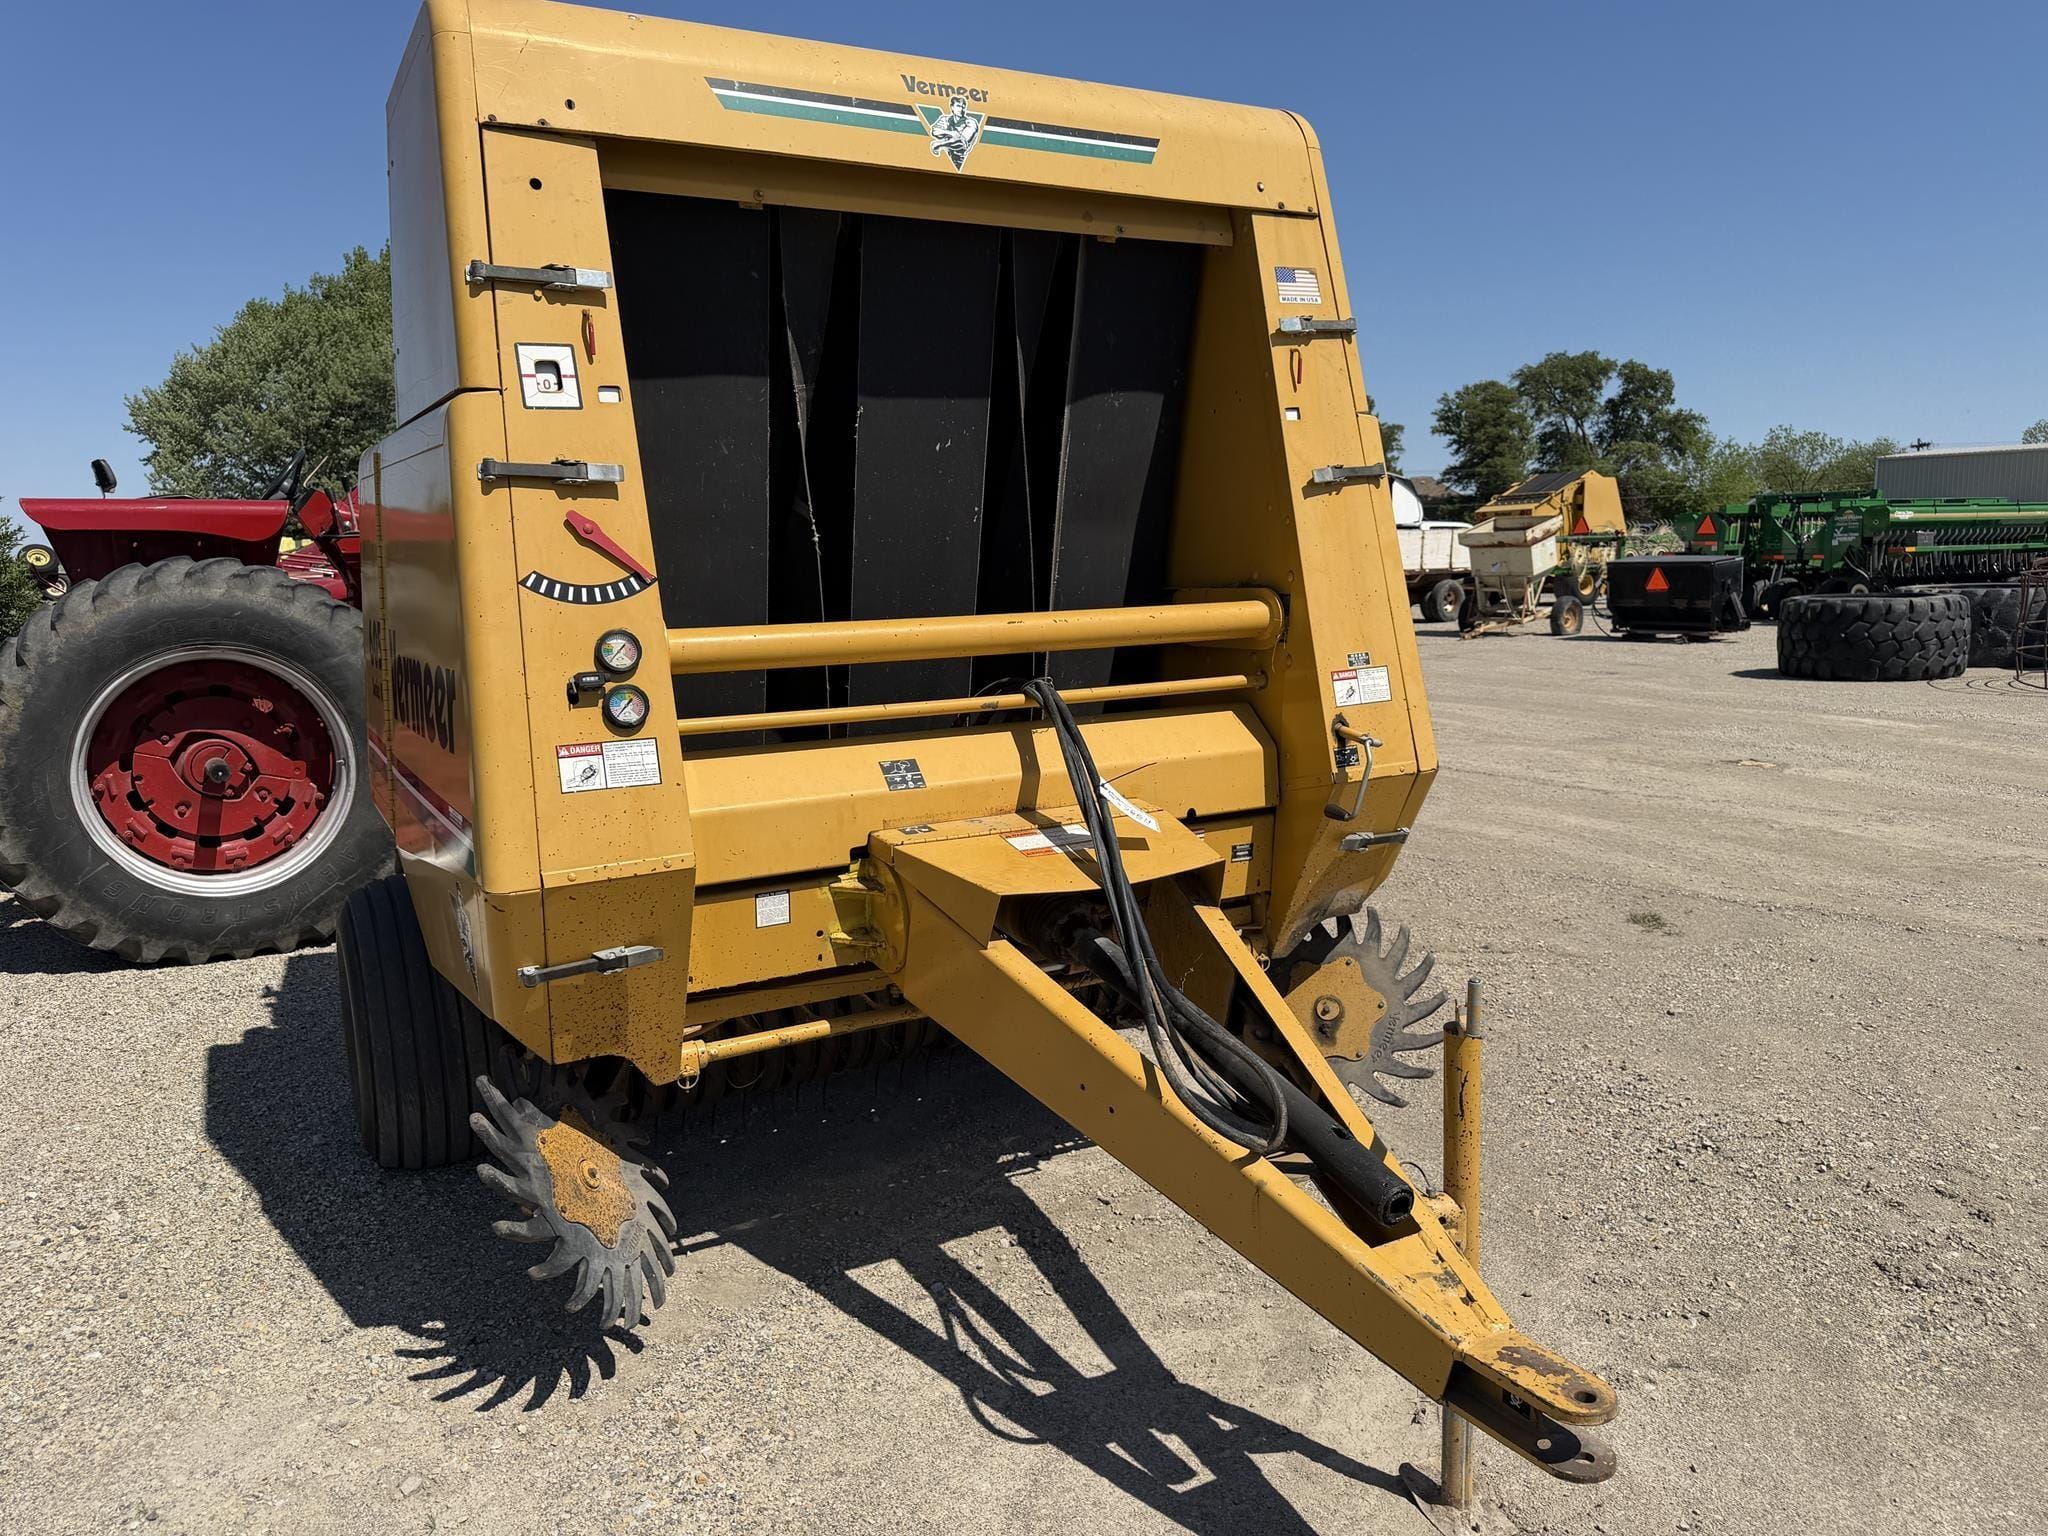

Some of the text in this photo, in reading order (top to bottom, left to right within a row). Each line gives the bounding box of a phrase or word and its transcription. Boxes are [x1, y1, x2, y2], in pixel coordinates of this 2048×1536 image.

[900, 74, 988, 103] Vermeer
[542, 379, 551, 390] 0
[388, 629, 456, 755] Vermeer
[570, 744, 601, 754] DANGER
